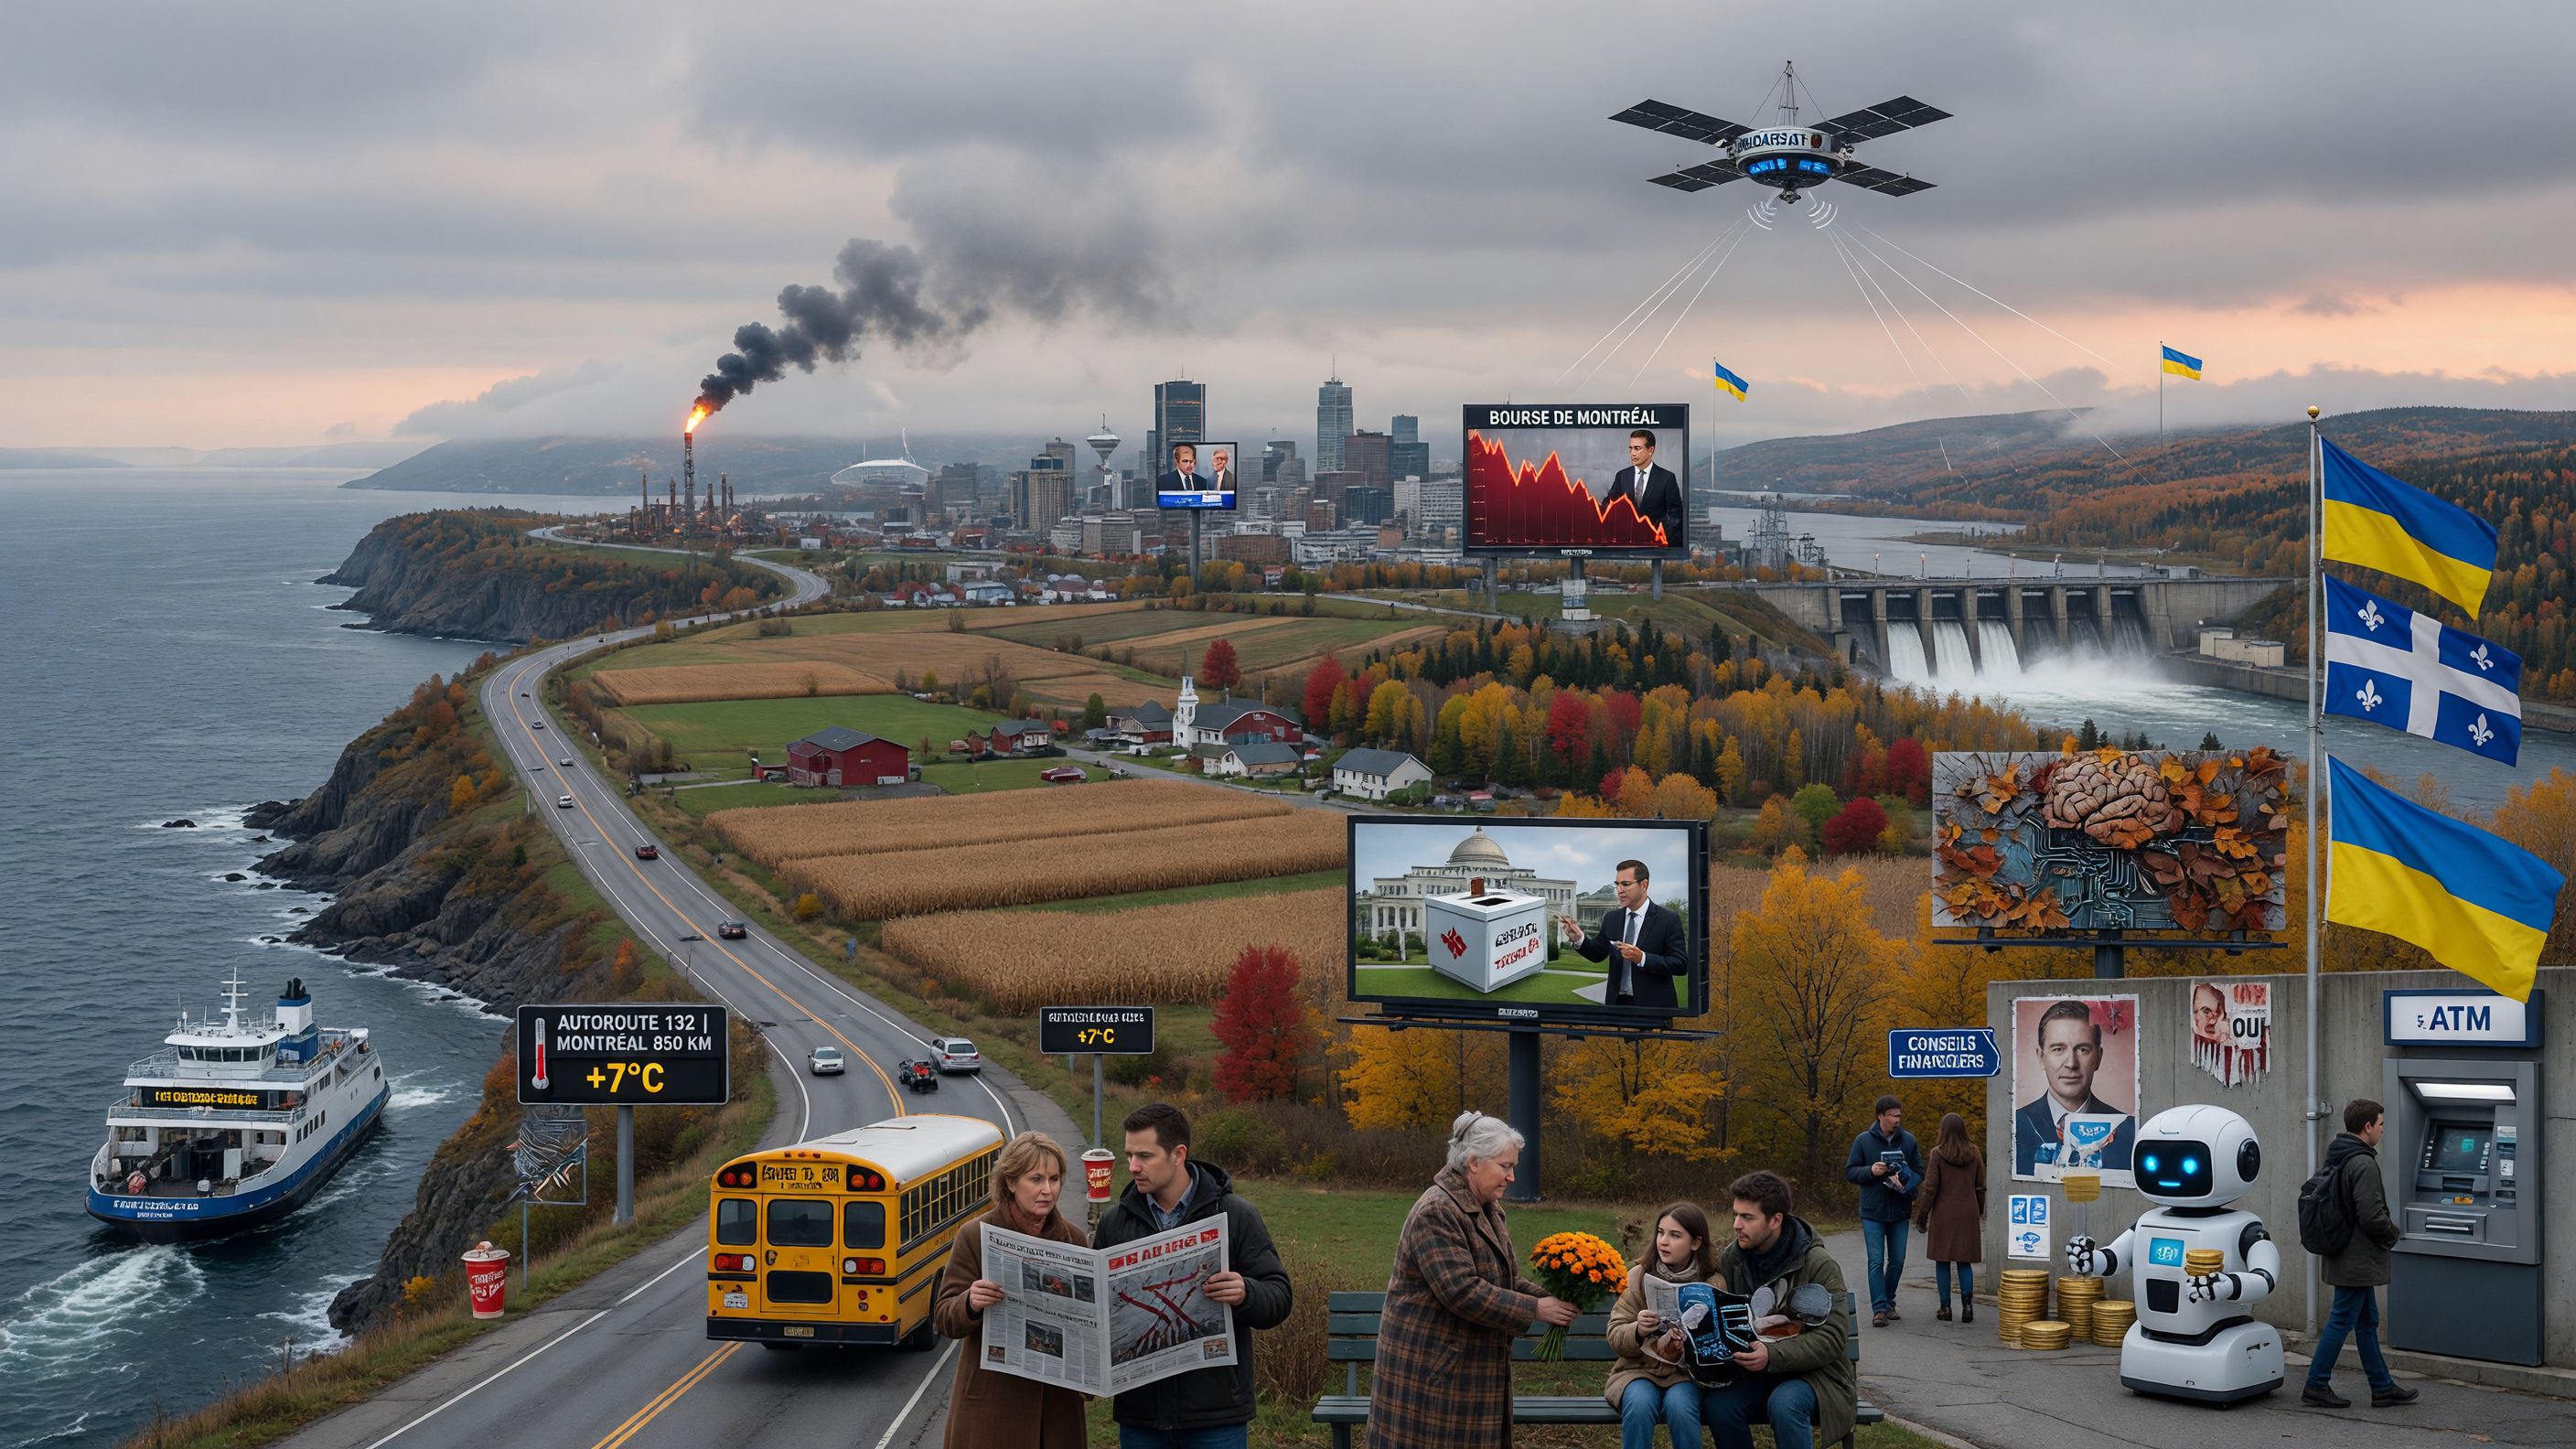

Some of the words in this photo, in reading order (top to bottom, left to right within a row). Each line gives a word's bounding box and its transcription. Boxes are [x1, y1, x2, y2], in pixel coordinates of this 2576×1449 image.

[1489, 410, 1551, 425] BOURSE
[1553, 410, 1573, 425] DE
[1577, 406, 1660, 425] MONTRÉAL
[557, 1014, 660, 1031] AUTOROUTE
[665, 1014, 695, 1031] 132
[2429, 1005, 2491, 1031] ATM
[556, 1033, 649, 1051] MONTRÉAL
[653, 1036, 683, 1051] 850
[688, 1036, 712, 1051] KM
[1907, 1036, 1977, 1051] CONSEILS
[585, 1062, 665, 1093] +7°C
